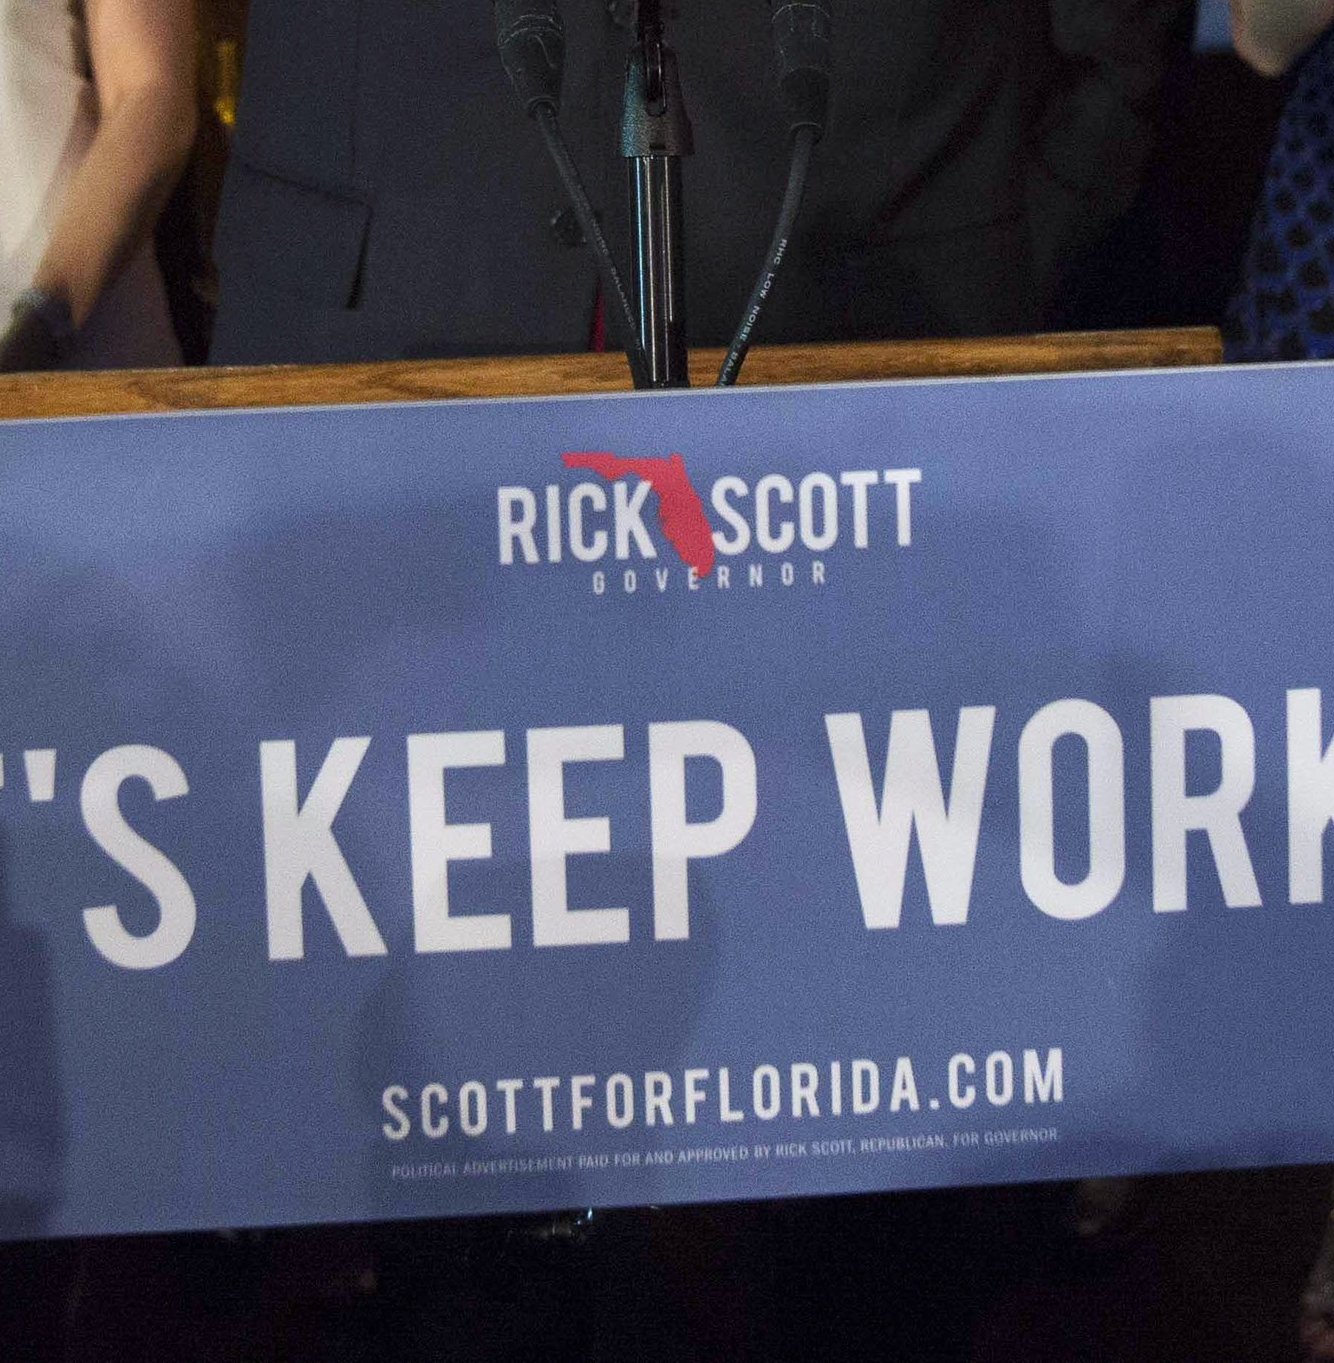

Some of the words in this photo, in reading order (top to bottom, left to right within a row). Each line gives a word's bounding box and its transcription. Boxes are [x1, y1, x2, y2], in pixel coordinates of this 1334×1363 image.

[759, 272, 775, 299] LOW
[497, 480, 657, 566] RICK
[710, 467, 923, 556] SCOTT
[591, 560, 827, 595] GOVERNOR
[259, 719, 758, 961] KEEP
[382, 1047, 1064, 1140] SCOTTFORFLORIDA.COM
[579, 1154, 609, 1169] PAID
[614, 1152, 641, 1167] FOR
[645, 1150, 674, 1165] AND
[678, 1146, 749, 1164] APPROVED
[754, 1144, 771, 1158] BY
[776, 1142, 807, 1157] RICK
[953, 1132, 979, 1147] FOR
[983, 1127, 1058, 1146] GOVERNOR
